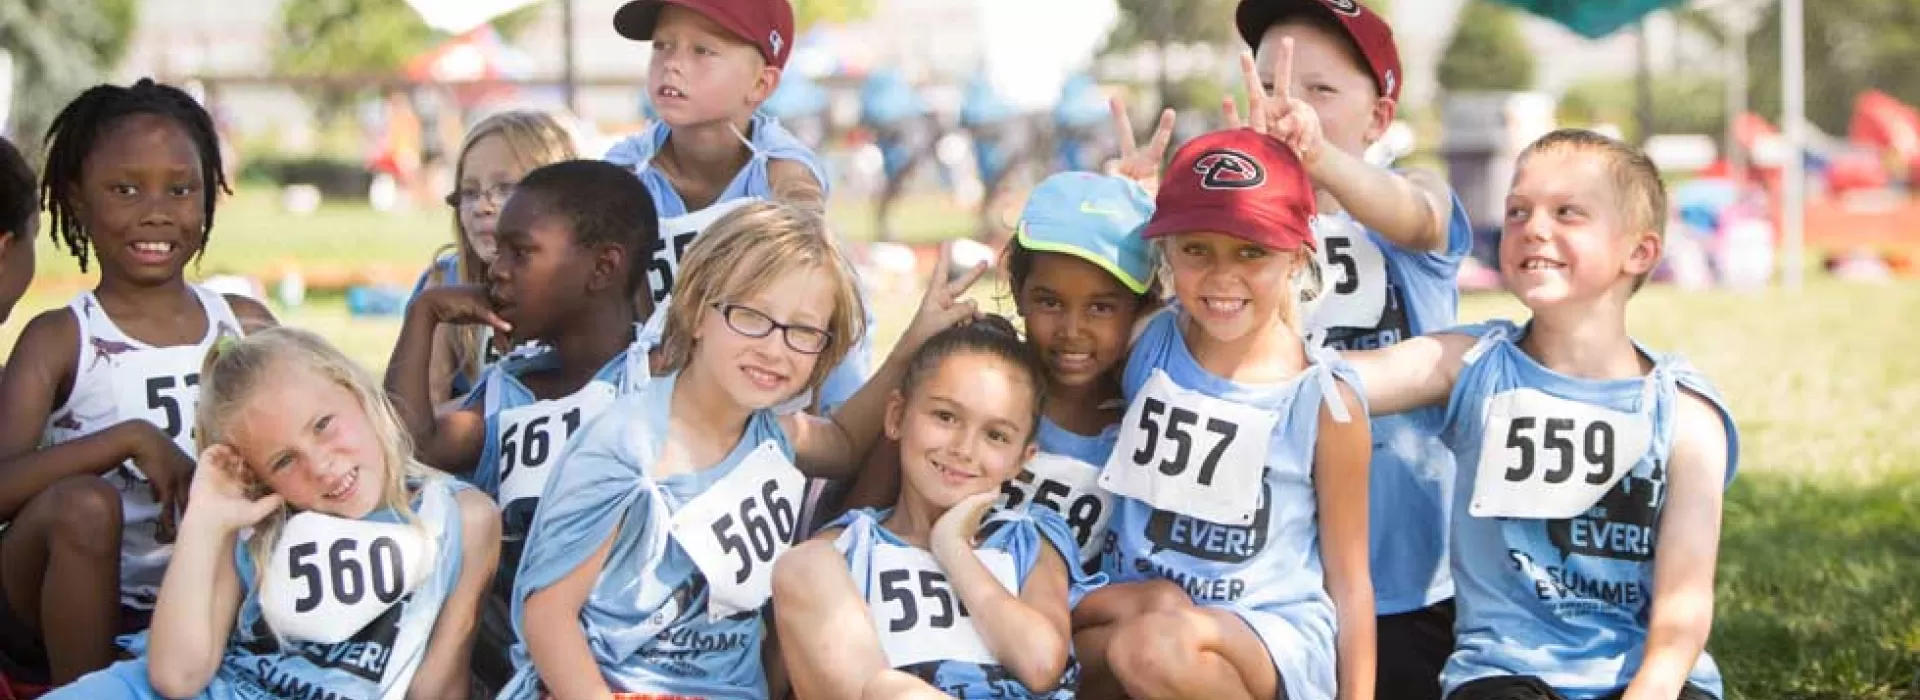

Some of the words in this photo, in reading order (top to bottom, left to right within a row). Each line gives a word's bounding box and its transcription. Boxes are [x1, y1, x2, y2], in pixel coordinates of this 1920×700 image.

[1133, 397, 1239, 486] 557
[1504, 417, 1615, 484] 559
[711, 479, 794, 584] 566
[1170, 515, 1256, 556] EVER!
[1570, 518, 1651, 554] EVER!
[289, 536, 405, 613] 560
[880, 569, 969, 632] 55
